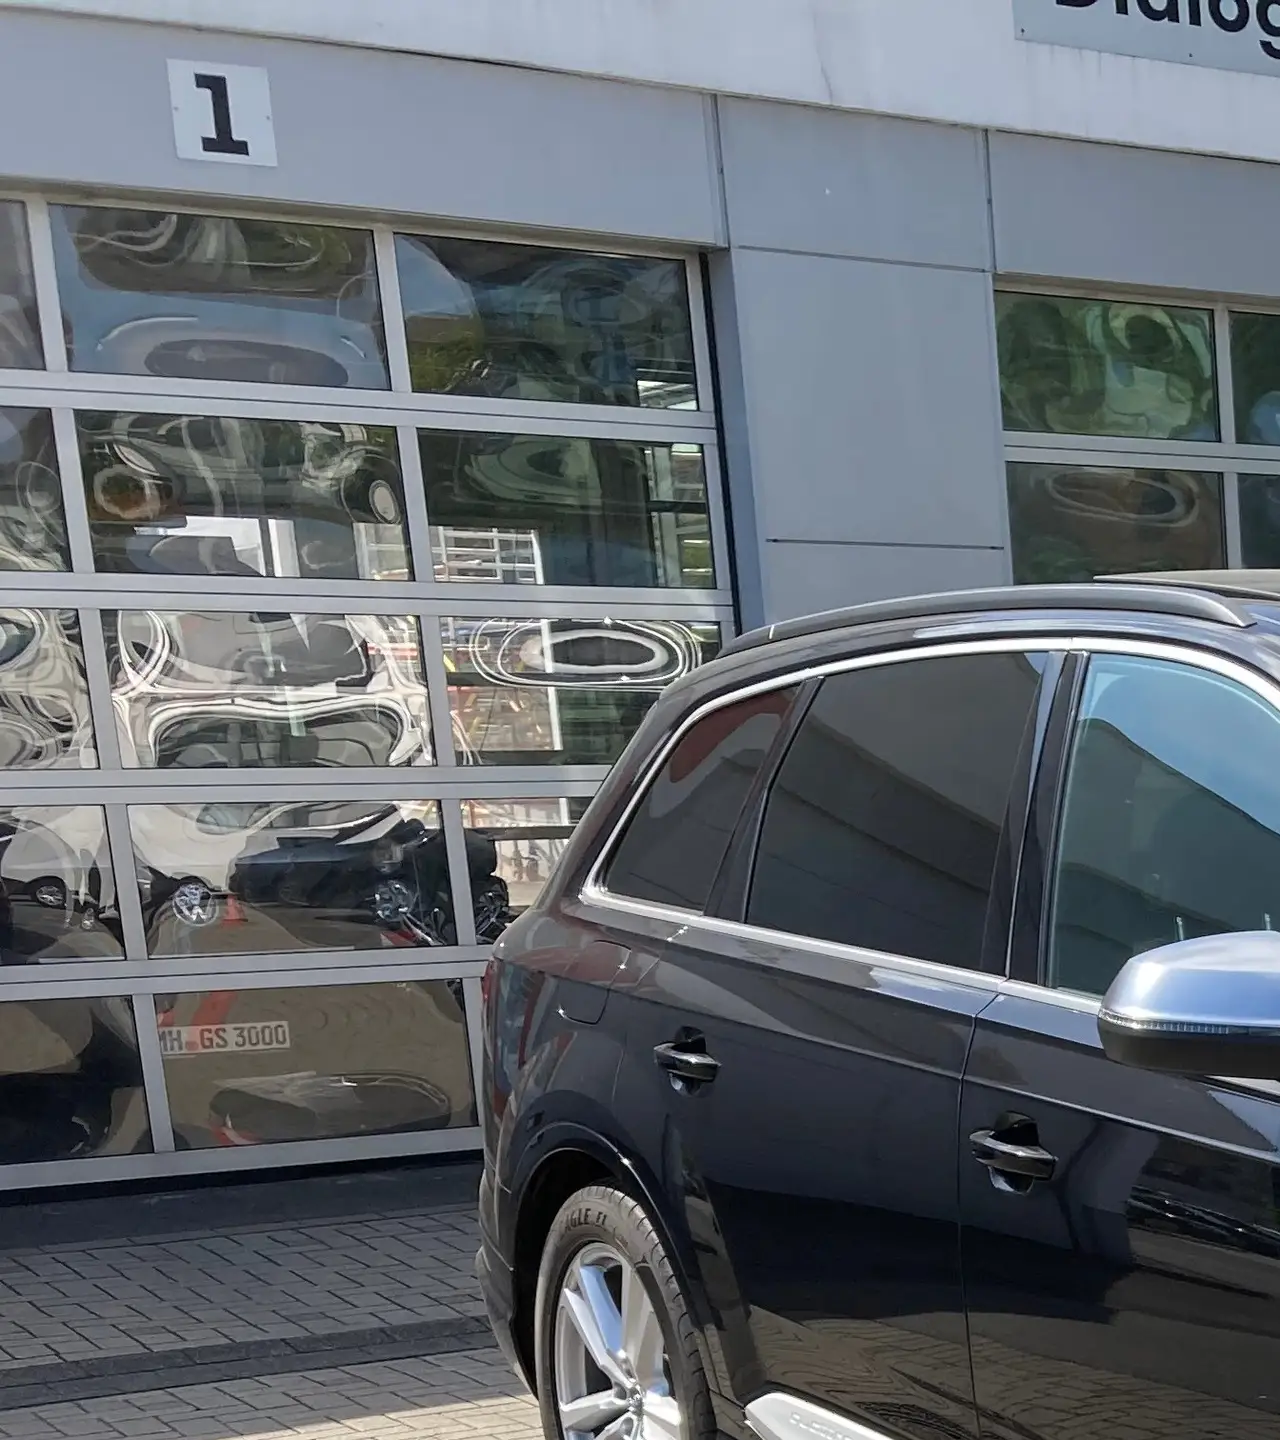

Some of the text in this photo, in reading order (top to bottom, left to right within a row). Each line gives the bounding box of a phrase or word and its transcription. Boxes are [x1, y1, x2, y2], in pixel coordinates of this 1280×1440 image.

[194, 73, 250, 156] 1
[200, 1028, 229, 1049] GS
[233, 1024, 287, 1047] 3000
